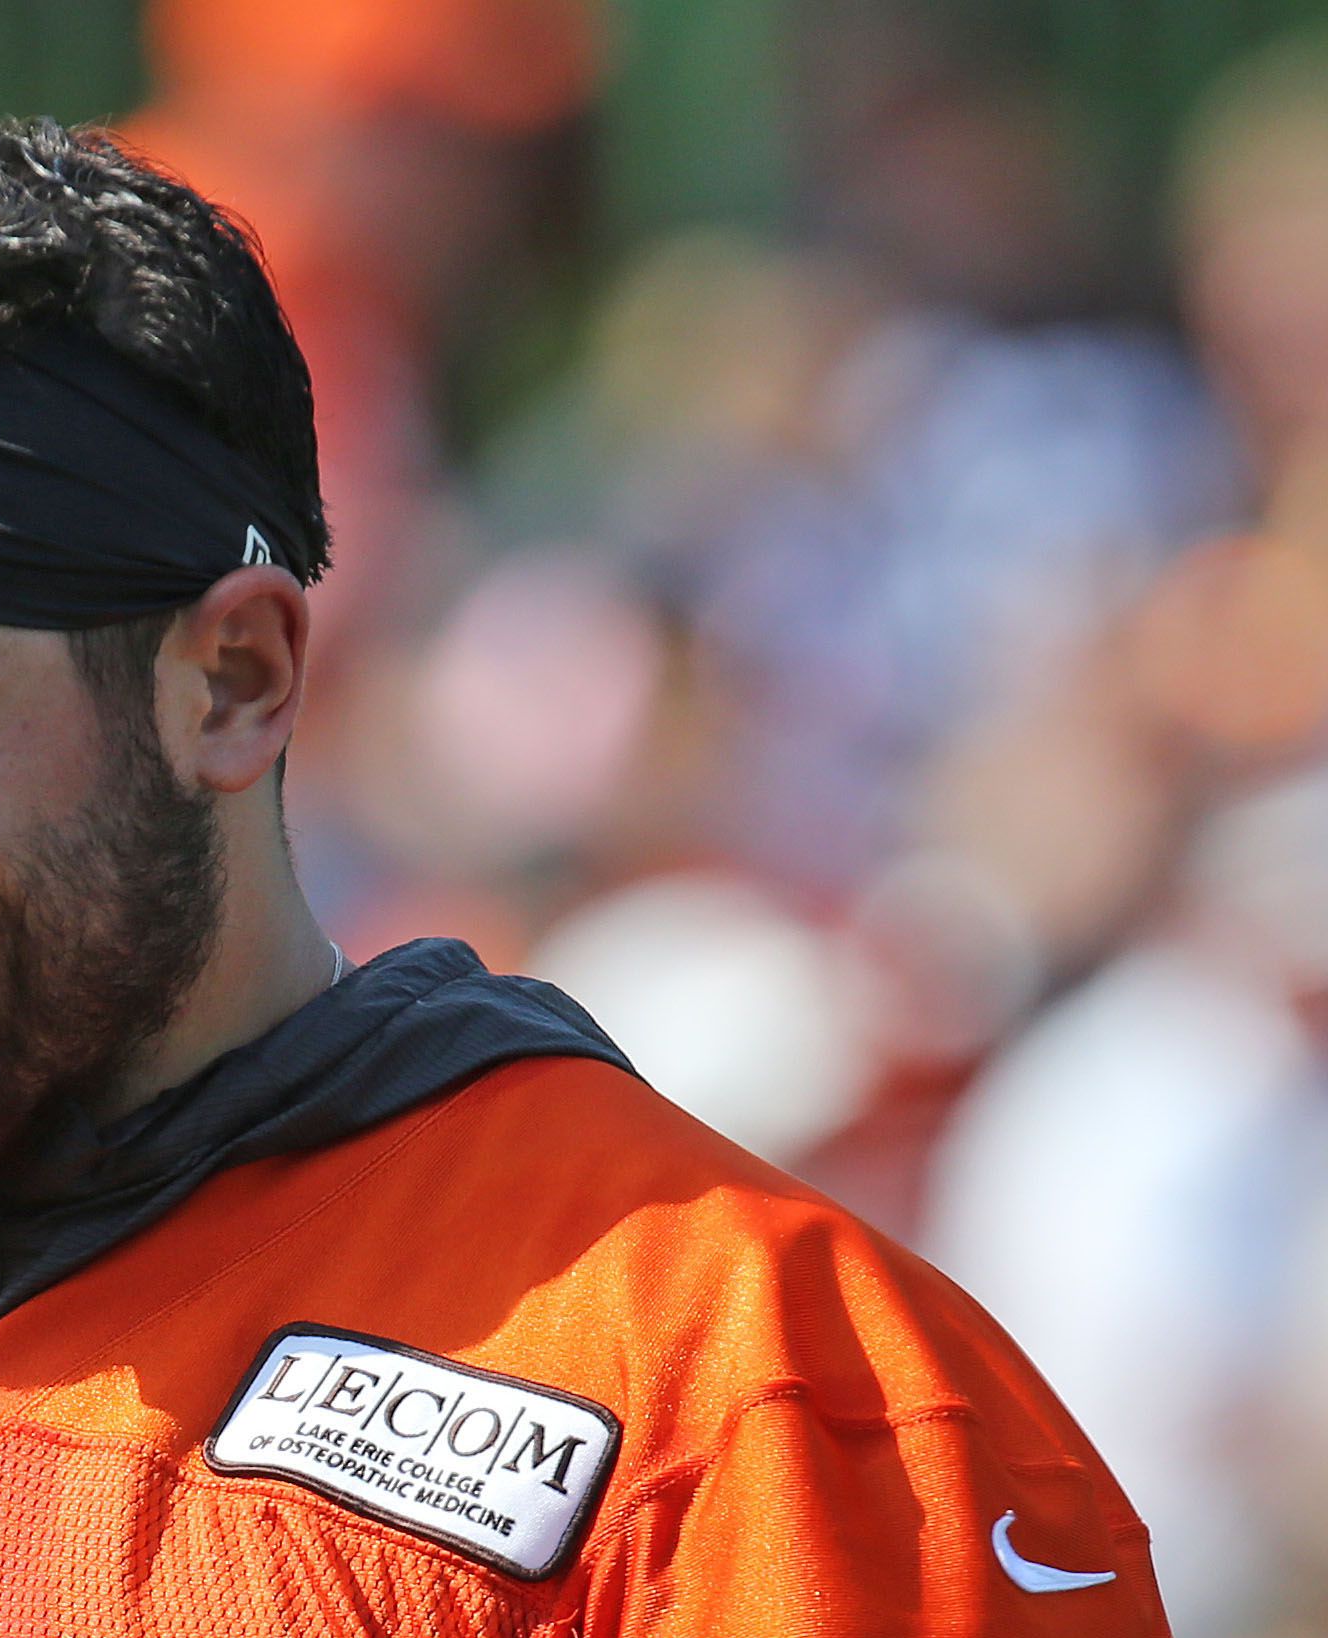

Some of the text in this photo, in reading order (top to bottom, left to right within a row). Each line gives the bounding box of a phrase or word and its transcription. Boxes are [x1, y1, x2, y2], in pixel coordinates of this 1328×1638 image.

[249, 1434, 517, 1537] OF OSTEOPATHIC MEDICINE
[296, 1421, 486, 1498] LAKE ERIE COLLEGE
